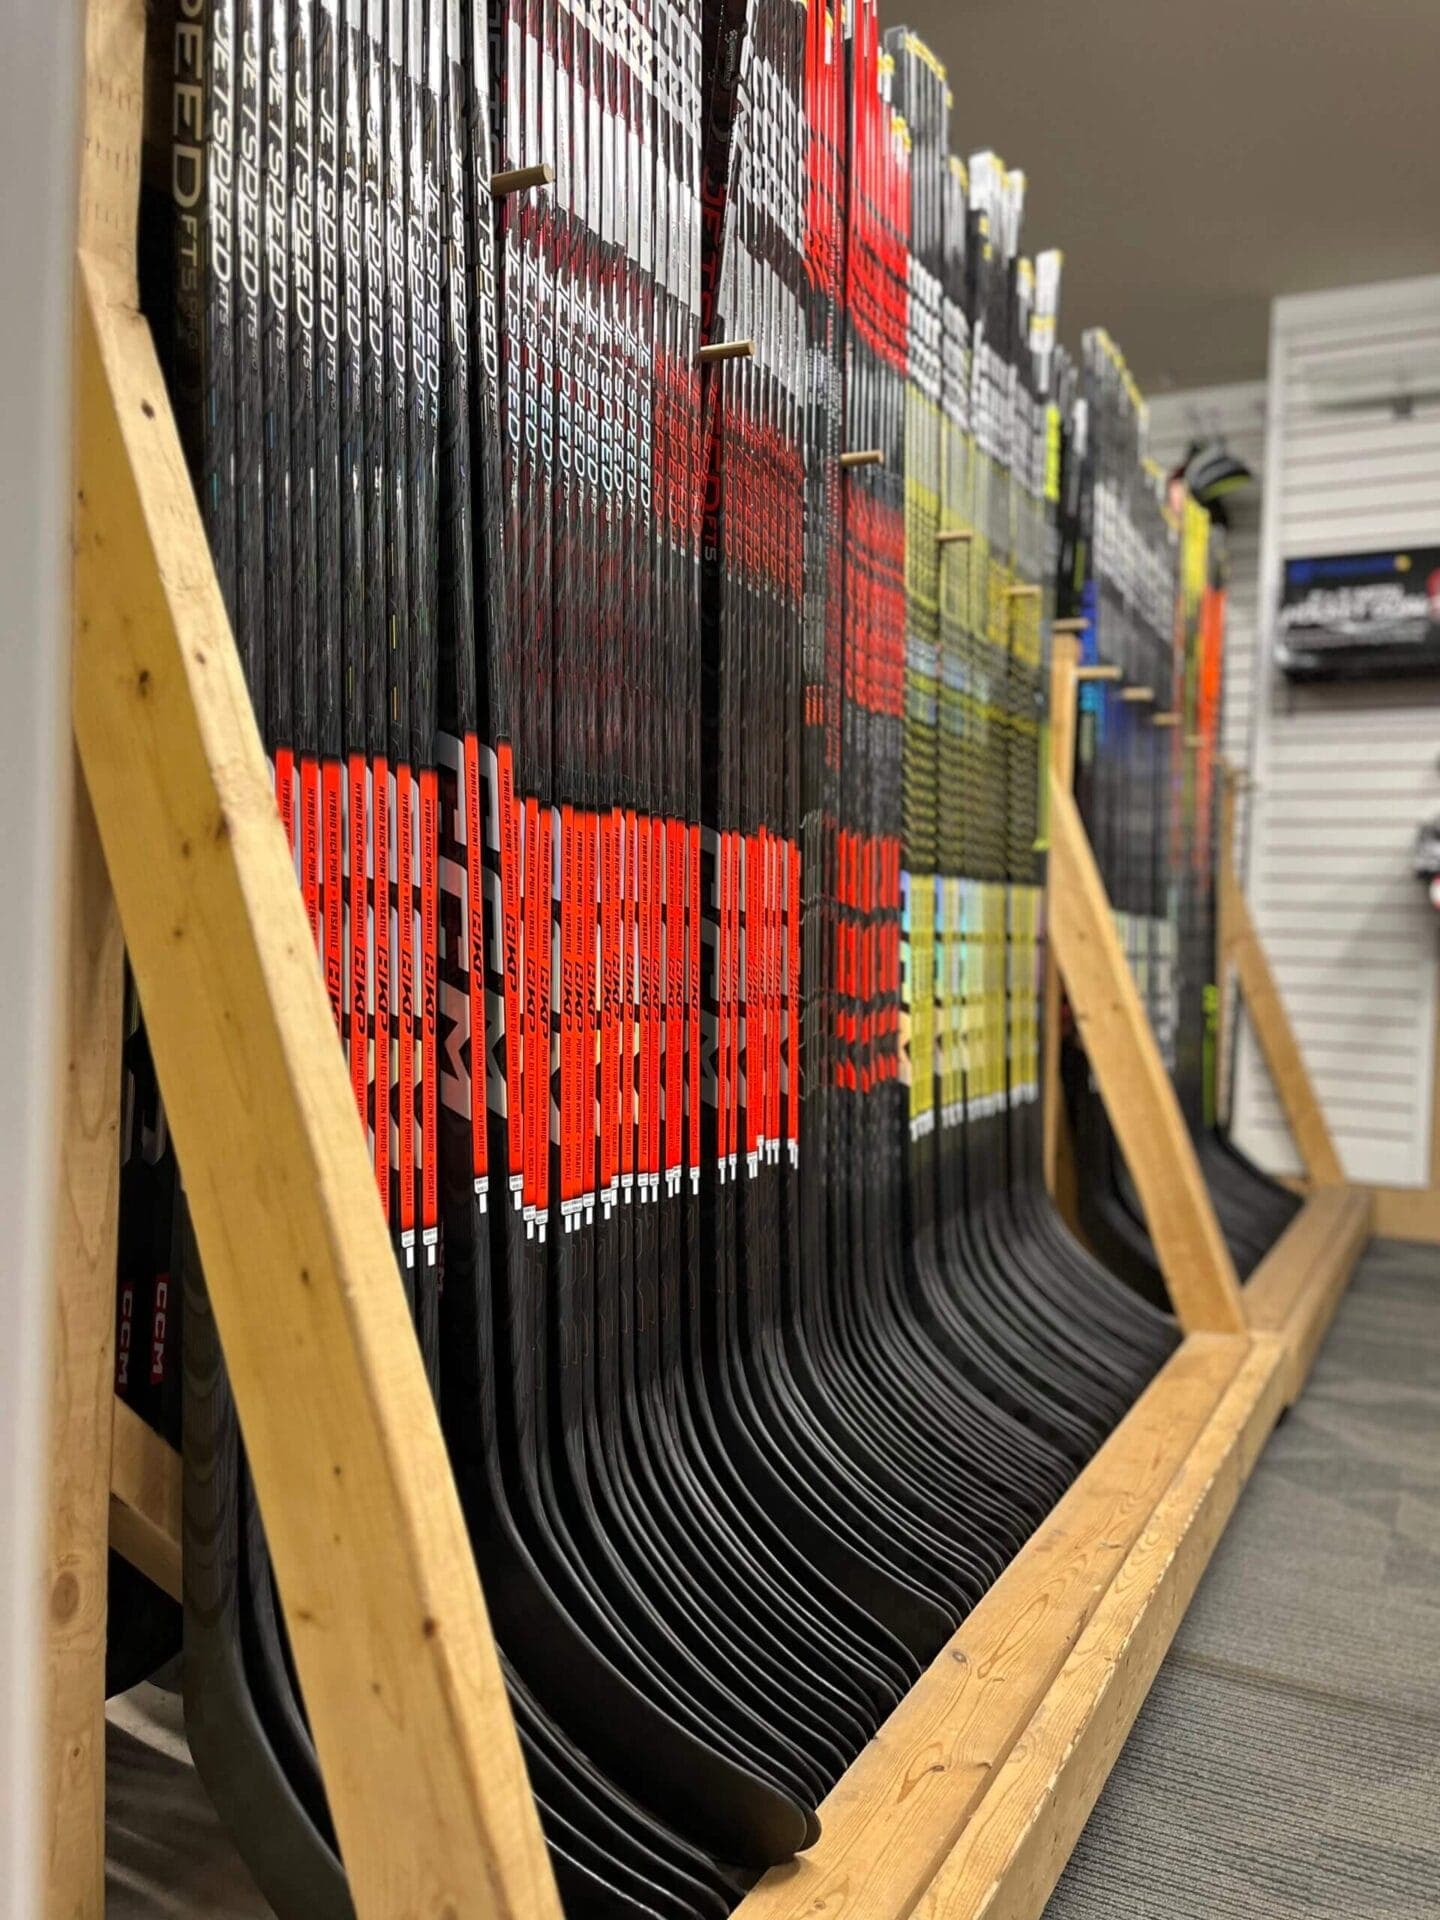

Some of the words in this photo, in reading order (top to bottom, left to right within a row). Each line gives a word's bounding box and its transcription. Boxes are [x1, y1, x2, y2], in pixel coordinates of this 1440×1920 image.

[212, 9, 231, 282] JETSPEED
[241, 30, 258, 297] JETSPEED
[269, 48, 286, 310] JETSPEED
[296, 71, 313, 330] JETSPEED
[320, 88, 336, 341] JETSPEED
[328, 342, 336, 380] FTS
[181, 215, 198, 291] FTS
[478, 156, 497, 377] JETSPEED
[219, 282, 228, 324] FTS
[247, 297, 257, 338] FTS
[276, 311, 286, 351] FTS
[303, 330, 312, 370] FTS
[509, 228, 520, 442] JETSPEED
[526, 240, 537, 448] JETSPEED
[542, 256, 553, 462] JETSPEED
[560, 268, 571, 469] JETSPEED
[574, 280, 586, 476] JETSPEED
[588, 293, 599, 484] JETSPEED
[601, 306, 612, 492] JETSPEED
[614, 308, 624, 492] JETSPEED
[640, 327, 651, 508] JETSPEED
[282, 778, 290, 817] HYBRID
[354, 782, 363, 820] HYBRID
[330, 899, 338, 949] VERSATILE
[472, 909, 483, 991] HKP
[506, 912, 517, 994] HKP
[355, 944, 366, 1035] HKP
[378, 944, 388, 1033] HKP
[402, 948, 412, 1035] HKP
[425, 951, 435, 1037] HKP
[540, 965, 550, 1040] HKP
[357, 1069, 364, 1081] DE
[118, 1289, 133, 1384] CCM
[152, 1281, 168, 1376] CCM
